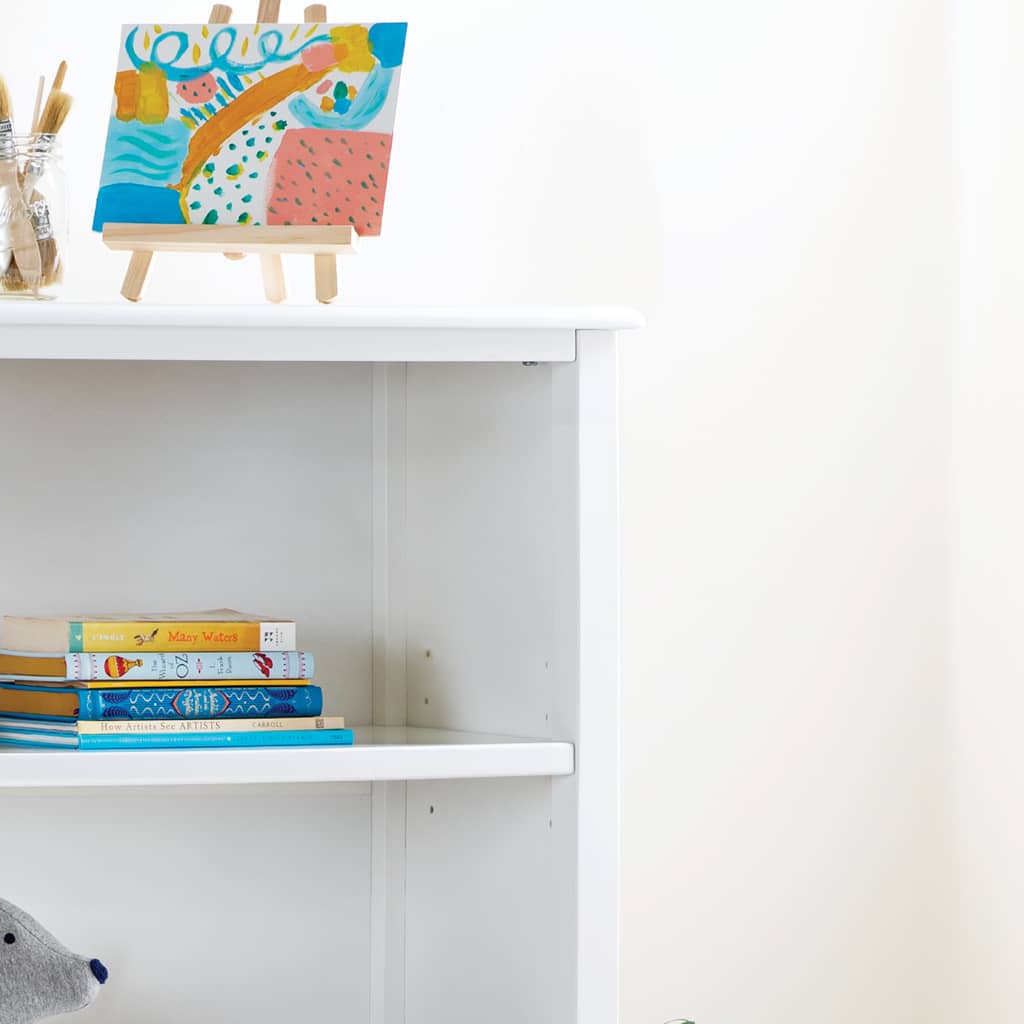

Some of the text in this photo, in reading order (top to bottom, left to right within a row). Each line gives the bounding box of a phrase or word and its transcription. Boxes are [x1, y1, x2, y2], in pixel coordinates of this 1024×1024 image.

[168, 631, 239, 645] Many Waters
[100, 720, 222, 732] How Artists See ARTISTS
